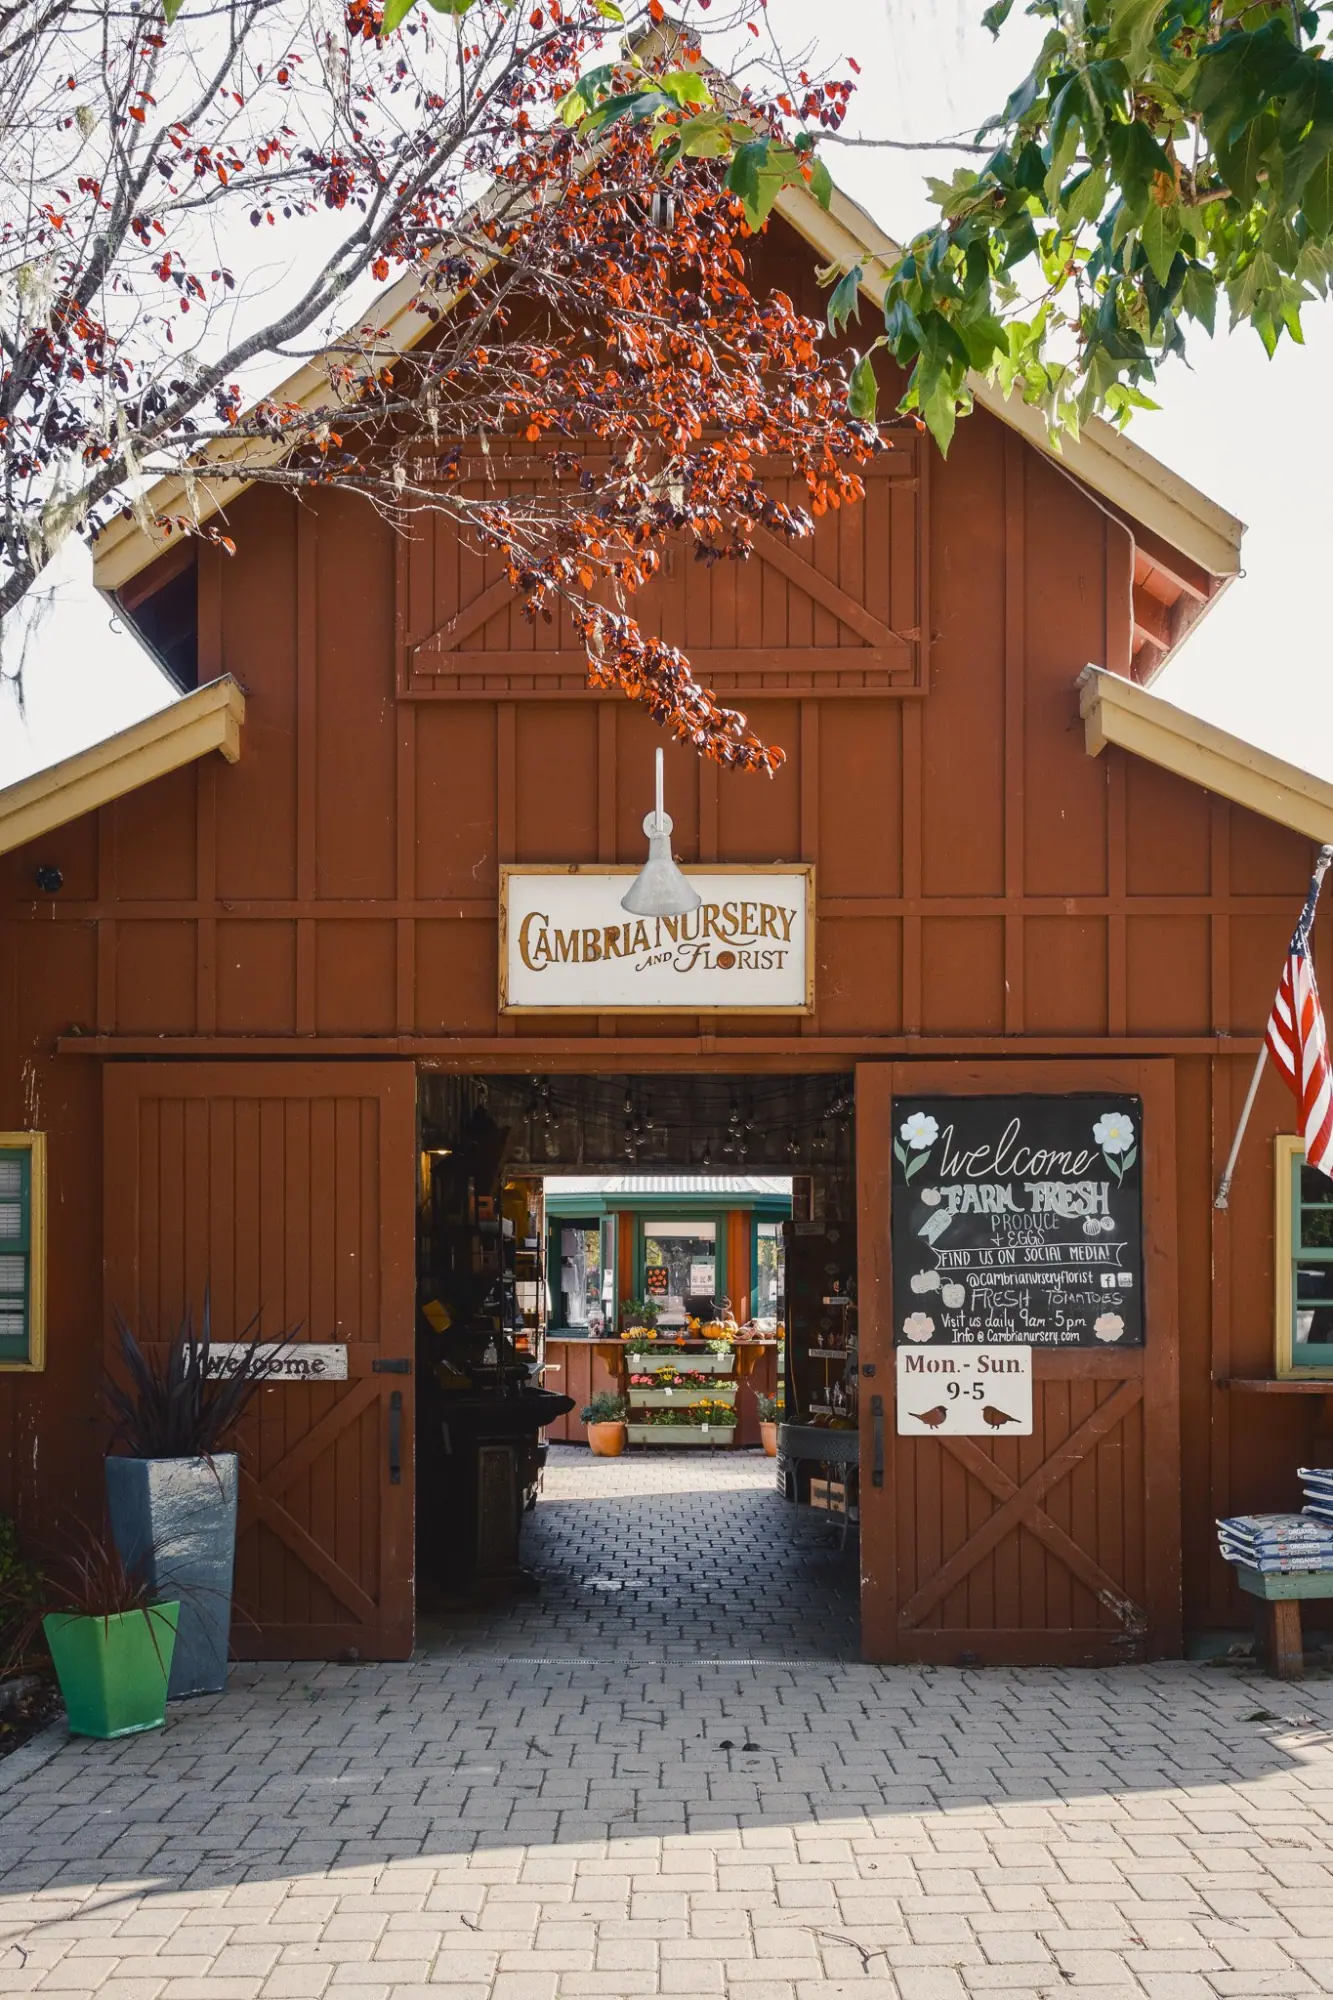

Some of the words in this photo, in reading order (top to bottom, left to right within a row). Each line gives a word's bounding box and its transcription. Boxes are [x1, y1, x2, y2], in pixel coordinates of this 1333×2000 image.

[518, 911, 652, 972] CAMBRIA
[654, 901, 797, 947] NURSERY
[635, 951, 672, 972] AND
[673, 943, 788, 973] FLORIST
[939, 1183, 1025, 1214] FARM
[1023, 1180, 1110, 1219] FRESH
[991, 1213, 1060, 1232] PRODUCE
[1007, 1229, 1045, 1247] EGGS
[941, 1251, 971, 1267] FIND
[979, 1250, 994, 1265] US
[998, 1248, 1016, 1264] ON
[1024, 1246, 1062, 1263] SOCIAL
[1069, 1244, 1110, 1261] MEDIA!
[966, 1270, 1094, 1290] @cambrianurseryflorist
[971, 1287, 1032, 1311] FRESH
[1042, 1289, 1125, 1306] TOMATOES
[941, 1310, 966, 1328] Visit
[969, 1317, 982, 1327] us
[984, 1307, 1015, 1332] daily
[1019, 1308, 1045, 1327] 9am
[951, 1327, 974, 1343] Info
[905, 1354, 961, 1373] Mon.
[977, 1354, 1025, 1373] Sun.
